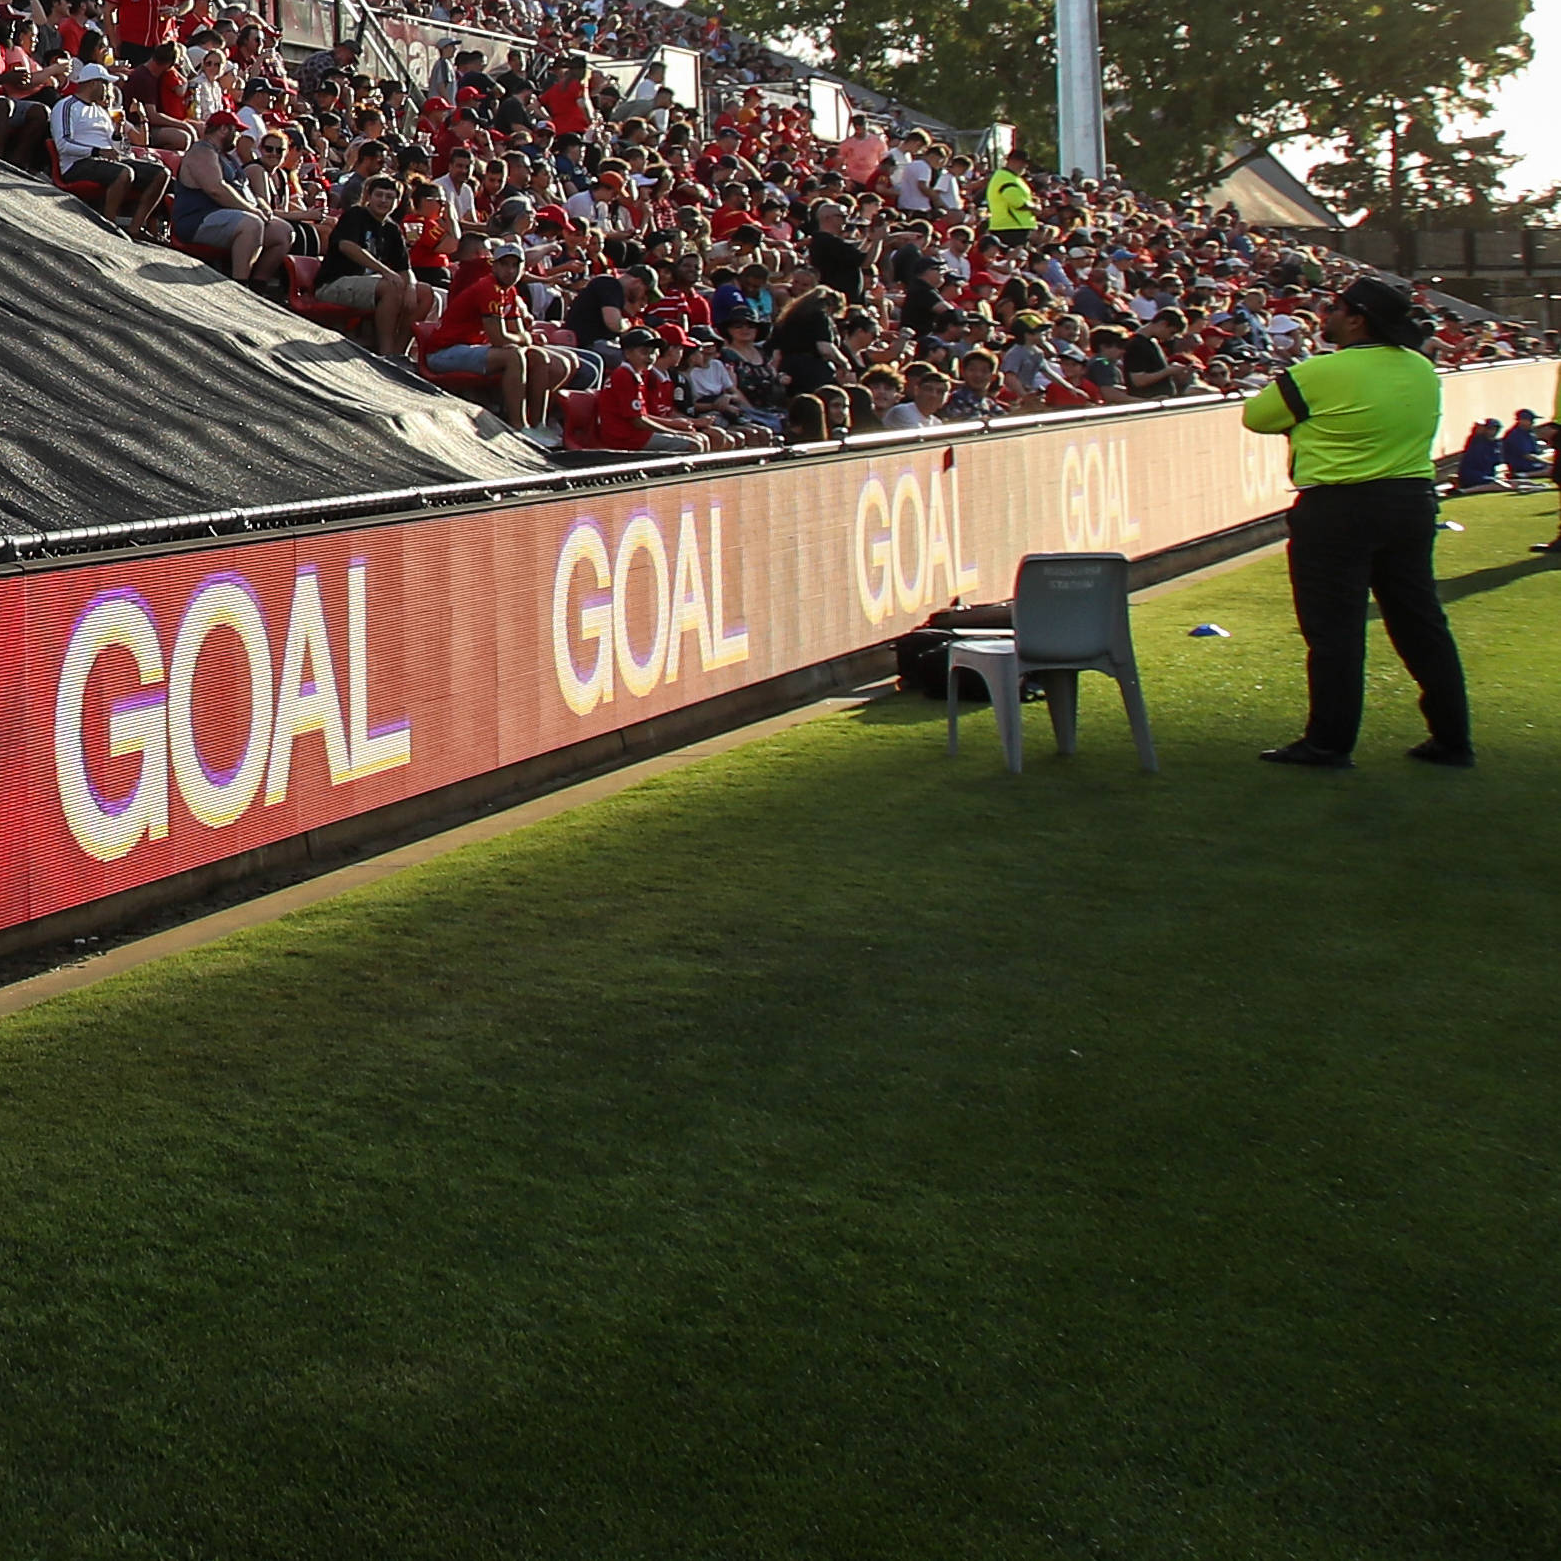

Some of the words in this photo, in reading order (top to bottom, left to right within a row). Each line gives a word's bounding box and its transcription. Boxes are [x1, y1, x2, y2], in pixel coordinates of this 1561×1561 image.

[855, 464, 978, 626] GOAL
[1062, 439, 1141, 552] GOAL
[552, 503, 749, 717] GOAL
[54, 556, 411, 863] GOAL
